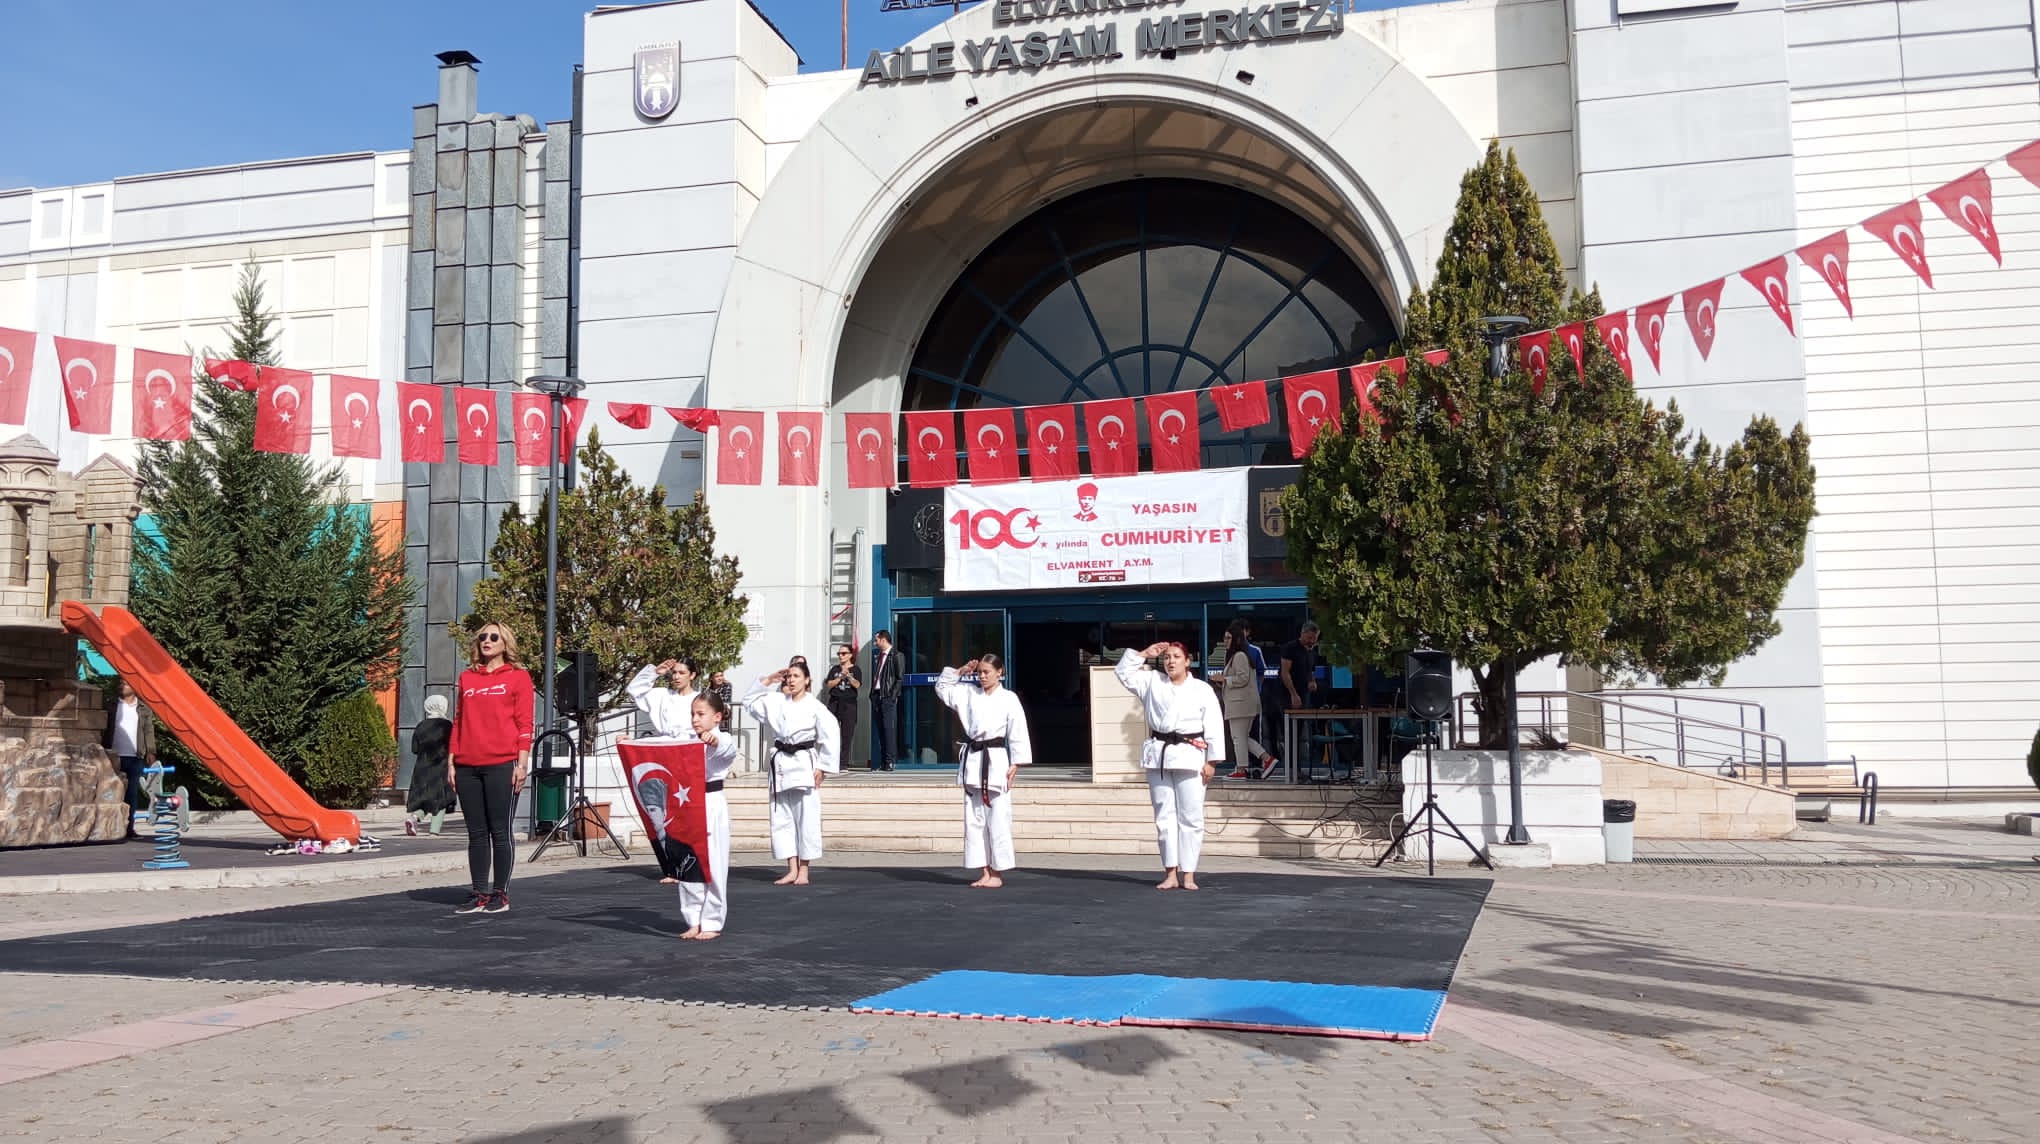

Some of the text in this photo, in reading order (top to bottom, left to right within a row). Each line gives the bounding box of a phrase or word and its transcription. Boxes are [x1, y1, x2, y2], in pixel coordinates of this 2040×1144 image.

[993, 0, 1181, 22] ELVAN
[963, 22, 1117, 71] YAŞAM
[1131, 502, 1197, 516] YAŞASIN
[1056, 540, 1088, 549] yılında
[1101, 526, 1235, 547] CUMHURİYET
[1047, 559, 1114, 571] ELVANKENT
